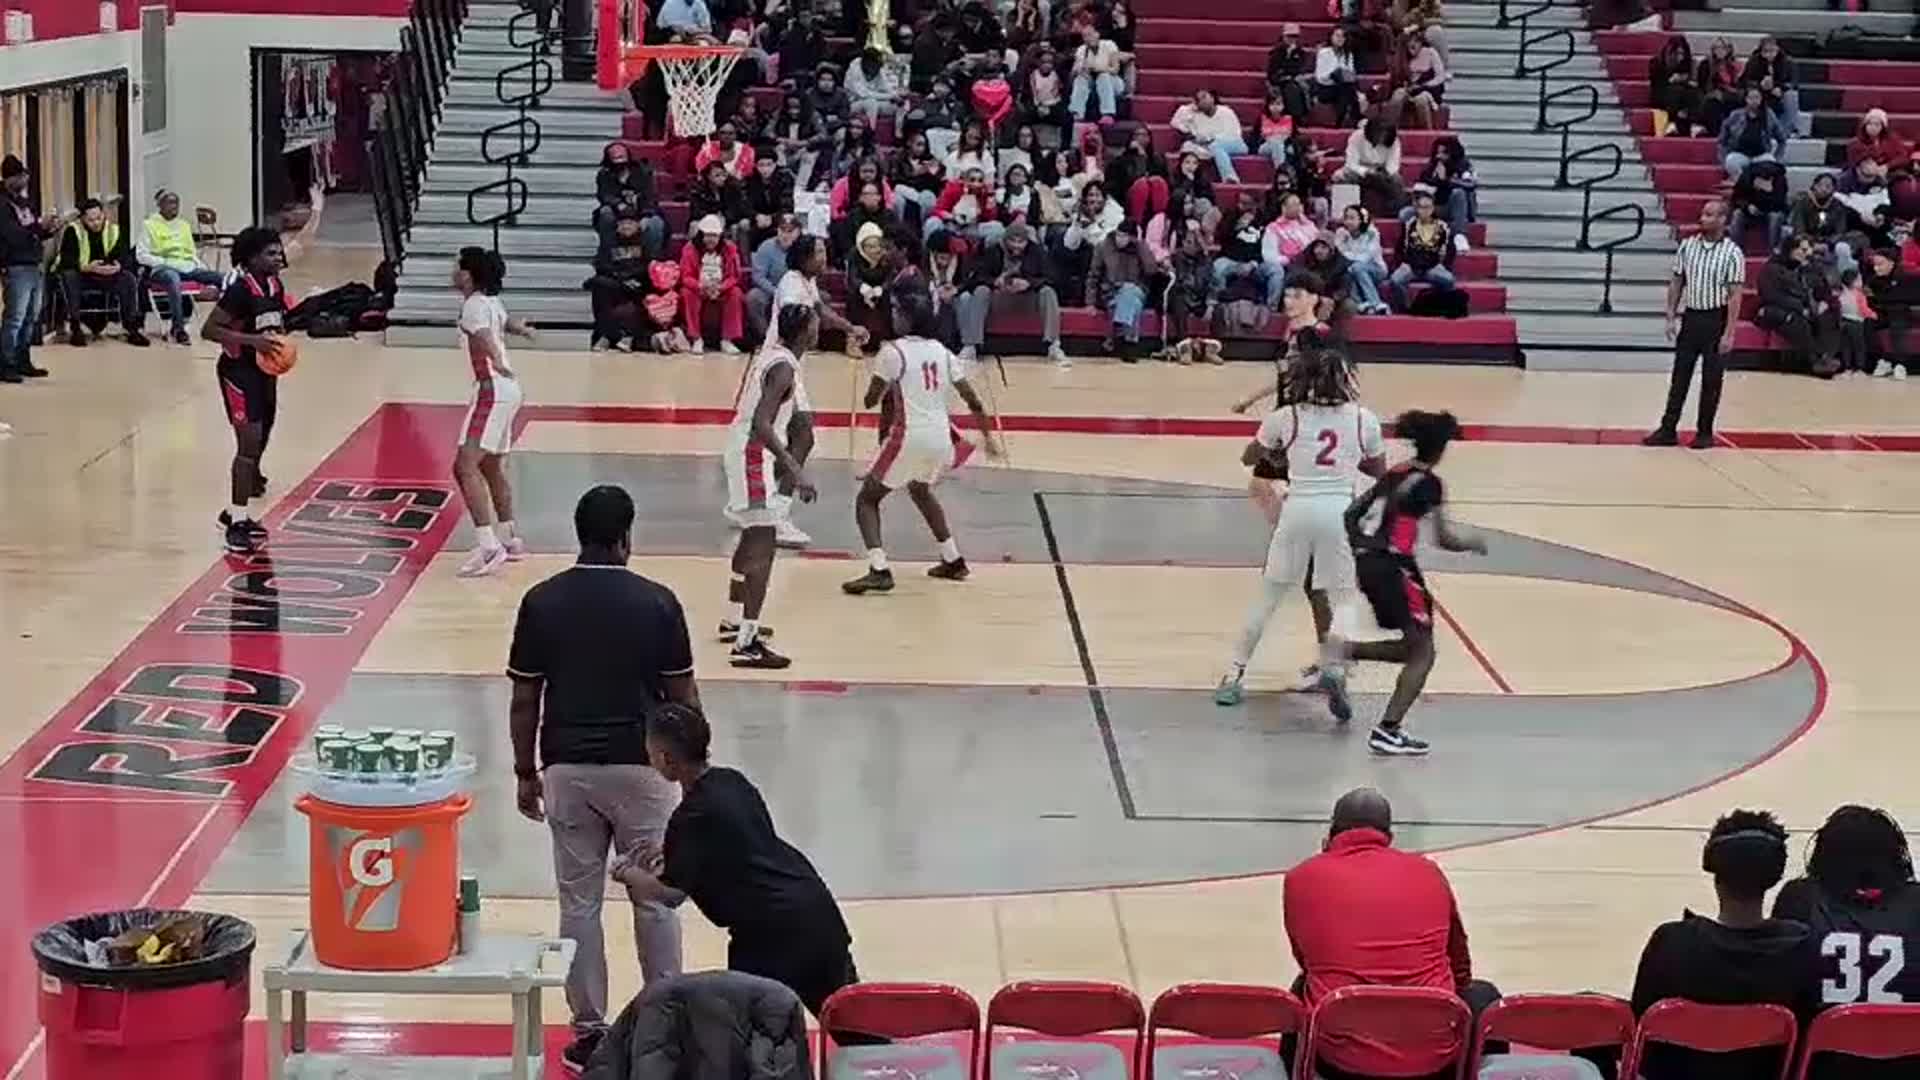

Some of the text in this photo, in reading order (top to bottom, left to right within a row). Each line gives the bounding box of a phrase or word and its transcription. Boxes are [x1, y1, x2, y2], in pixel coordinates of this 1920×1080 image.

[922, 360, 938, 391] 11
[1315, 428, 1338, 466] 2
[25, 480, 453, 798] RED WOLVES
[350, 837, 395, 886] G
[1821, 932, 1905, 1003] 32
